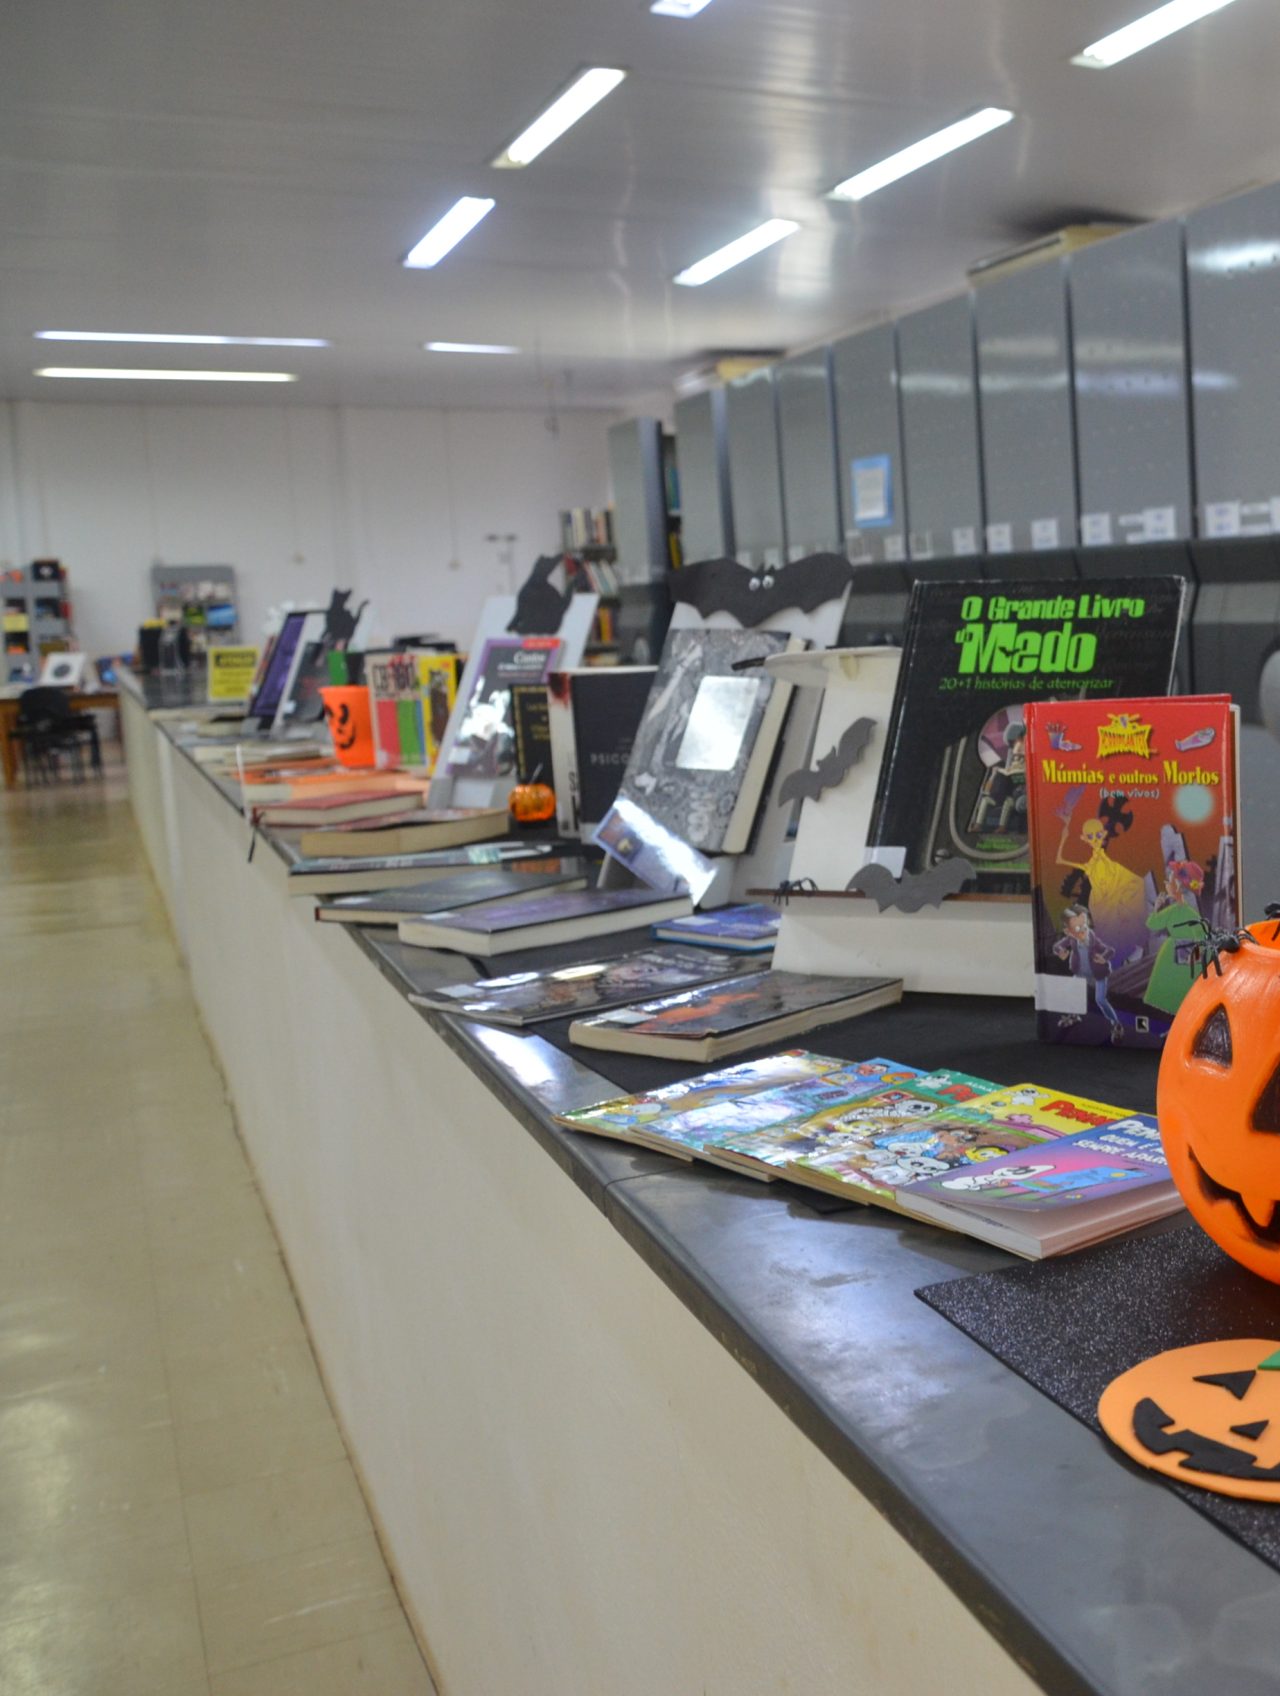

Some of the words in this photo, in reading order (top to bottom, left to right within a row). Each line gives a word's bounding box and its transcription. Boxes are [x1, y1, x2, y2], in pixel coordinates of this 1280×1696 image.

[960, 596, 983, 621] O
[987, 595, 1076, 621] Grande
[1078, 594, 1145, 619] Livro
[958, 622, 1098, 674] Medo
[1029, 676, 1044, 690] de
[1047, 678, 1114, 690] aterrorizar
[1042, 758, 1104, 784] Múmias
[1108, 771, 1116, 784] e
[1119, 769, 1158, 784] outros
[1162, 760, 1220, 785] Mortos
[1127, 787, 1160, 800] vivos)
[1071, 1139, 1126, 1155] SEMPRE
